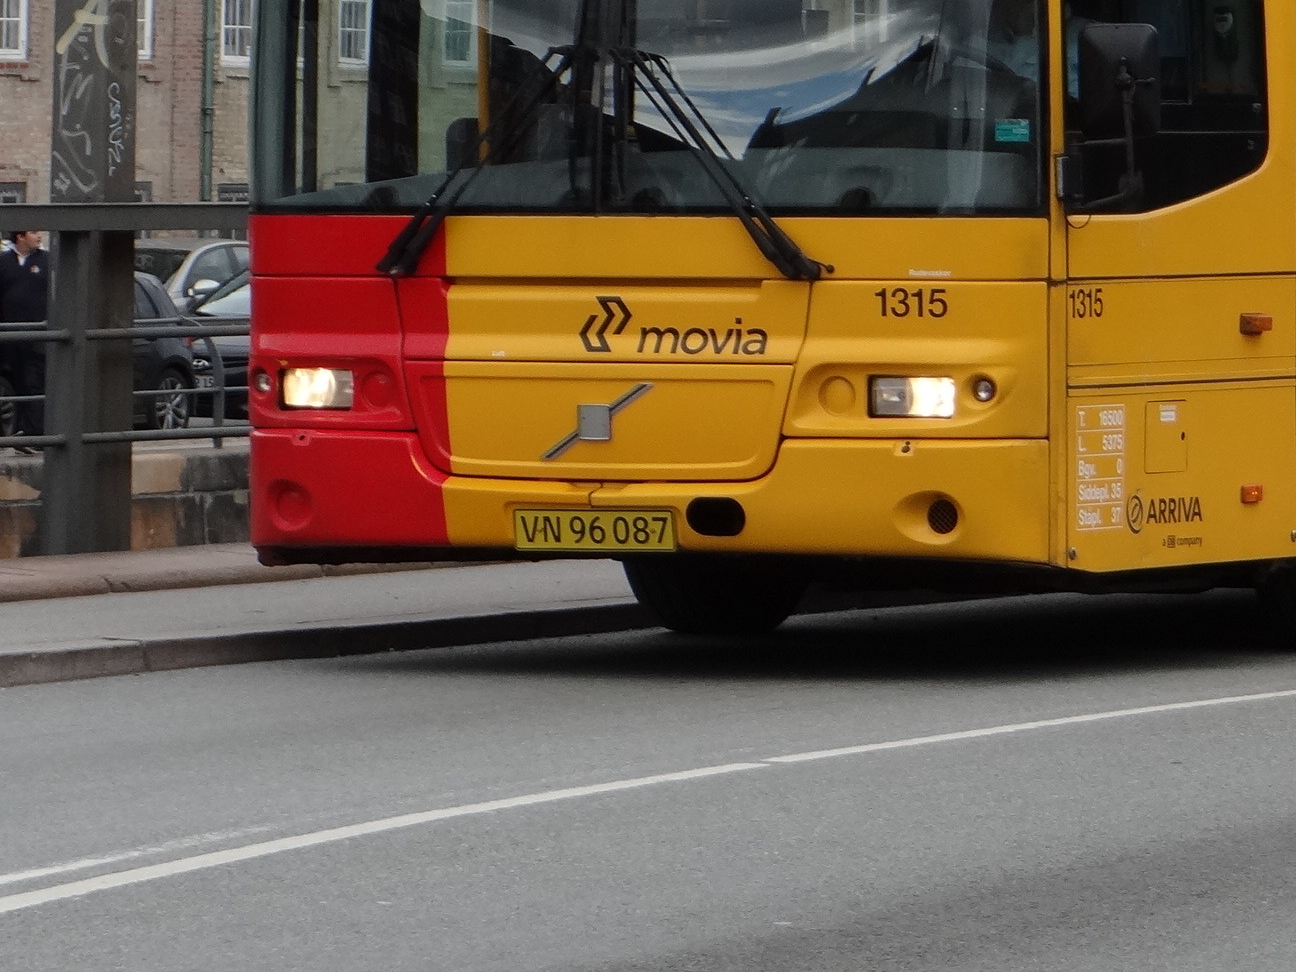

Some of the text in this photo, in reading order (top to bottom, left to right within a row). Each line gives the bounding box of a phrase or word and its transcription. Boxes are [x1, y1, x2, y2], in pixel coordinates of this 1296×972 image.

[875, 288, 948, 318] 1315
[1069, 288, 1104, 319] 1315
[636, 317, 769, 355] movia
[1146, 497, 1203, 524] ARRIVA
[520, 515, 669, 544] VN 96 087
